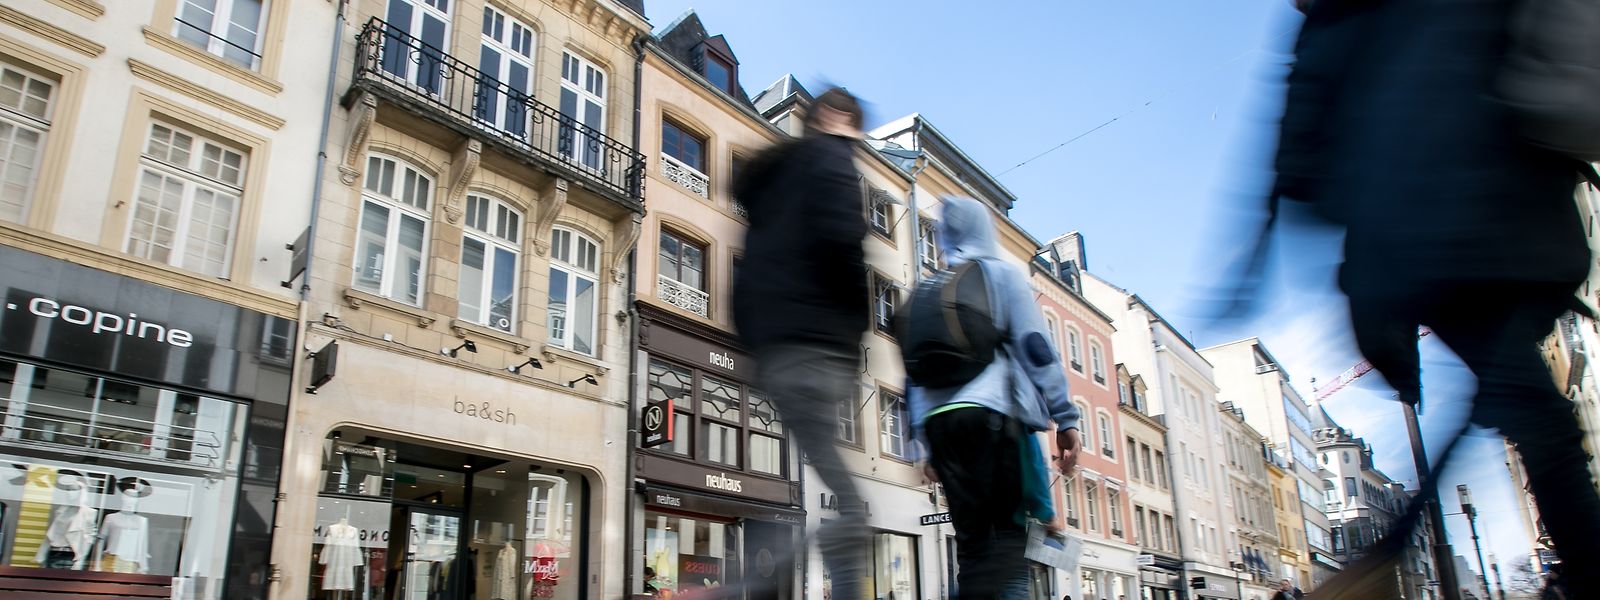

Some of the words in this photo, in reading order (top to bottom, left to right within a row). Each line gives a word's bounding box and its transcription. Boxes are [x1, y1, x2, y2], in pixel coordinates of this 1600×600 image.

[709, 351, 734, 370] neuha
[454, 395, 516, 426] ba&sh
[705, 472, 743, 493] neuhaus
[656, 494, 681, 507] neuhaus
[922, 513, 952, 524] LANCE
